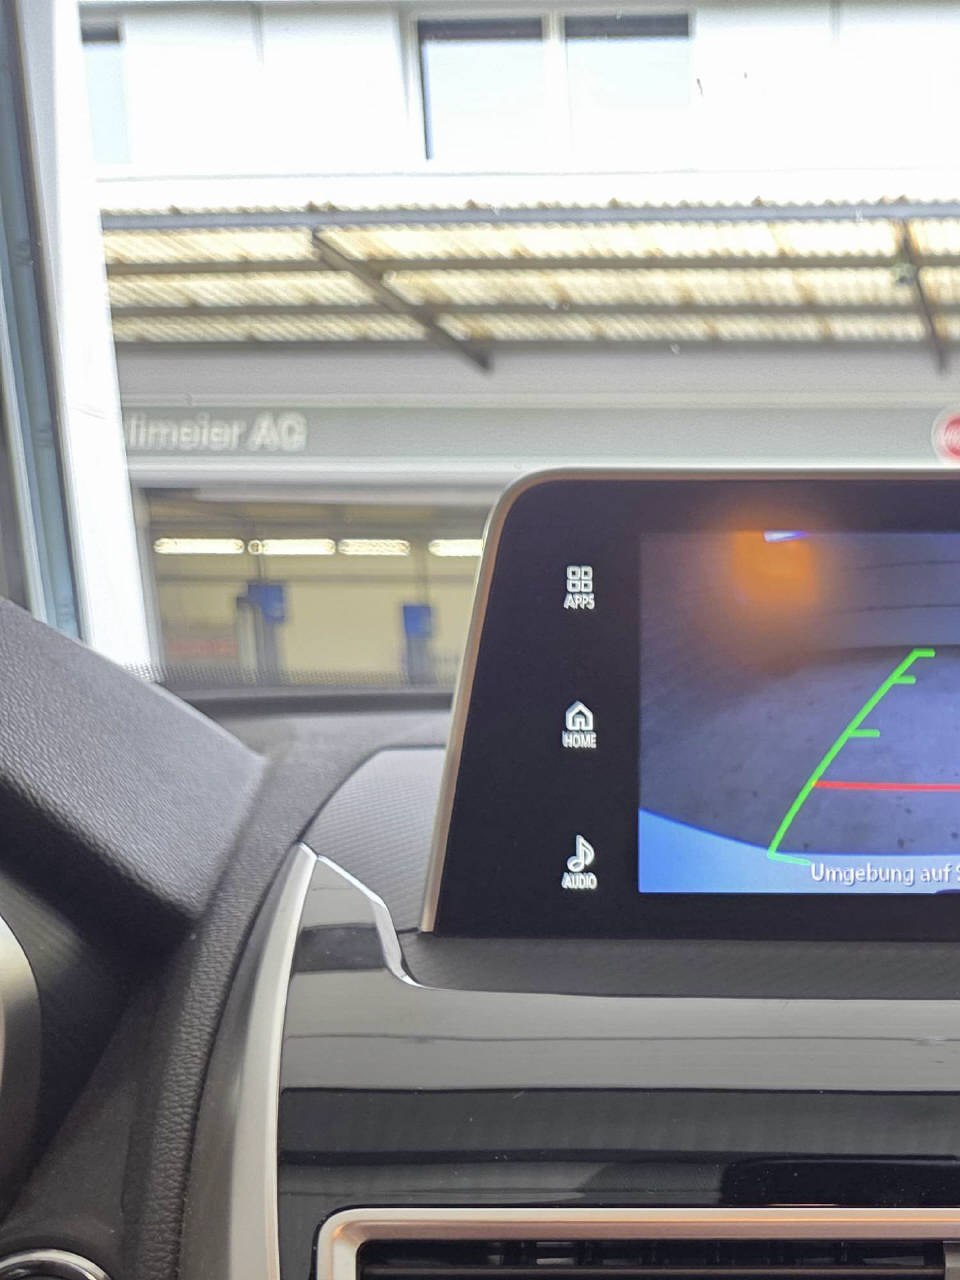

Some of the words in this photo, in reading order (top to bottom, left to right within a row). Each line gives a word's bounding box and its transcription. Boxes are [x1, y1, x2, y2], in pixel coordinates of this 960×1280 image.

[563, 593, 595, 610] APPS
[562, 731, 597, 748] HOME
[562, 872, 598, 889] AUDIO
[810, 864, 915, 886] Umgebung
[919, 863, 952, 882] auf
